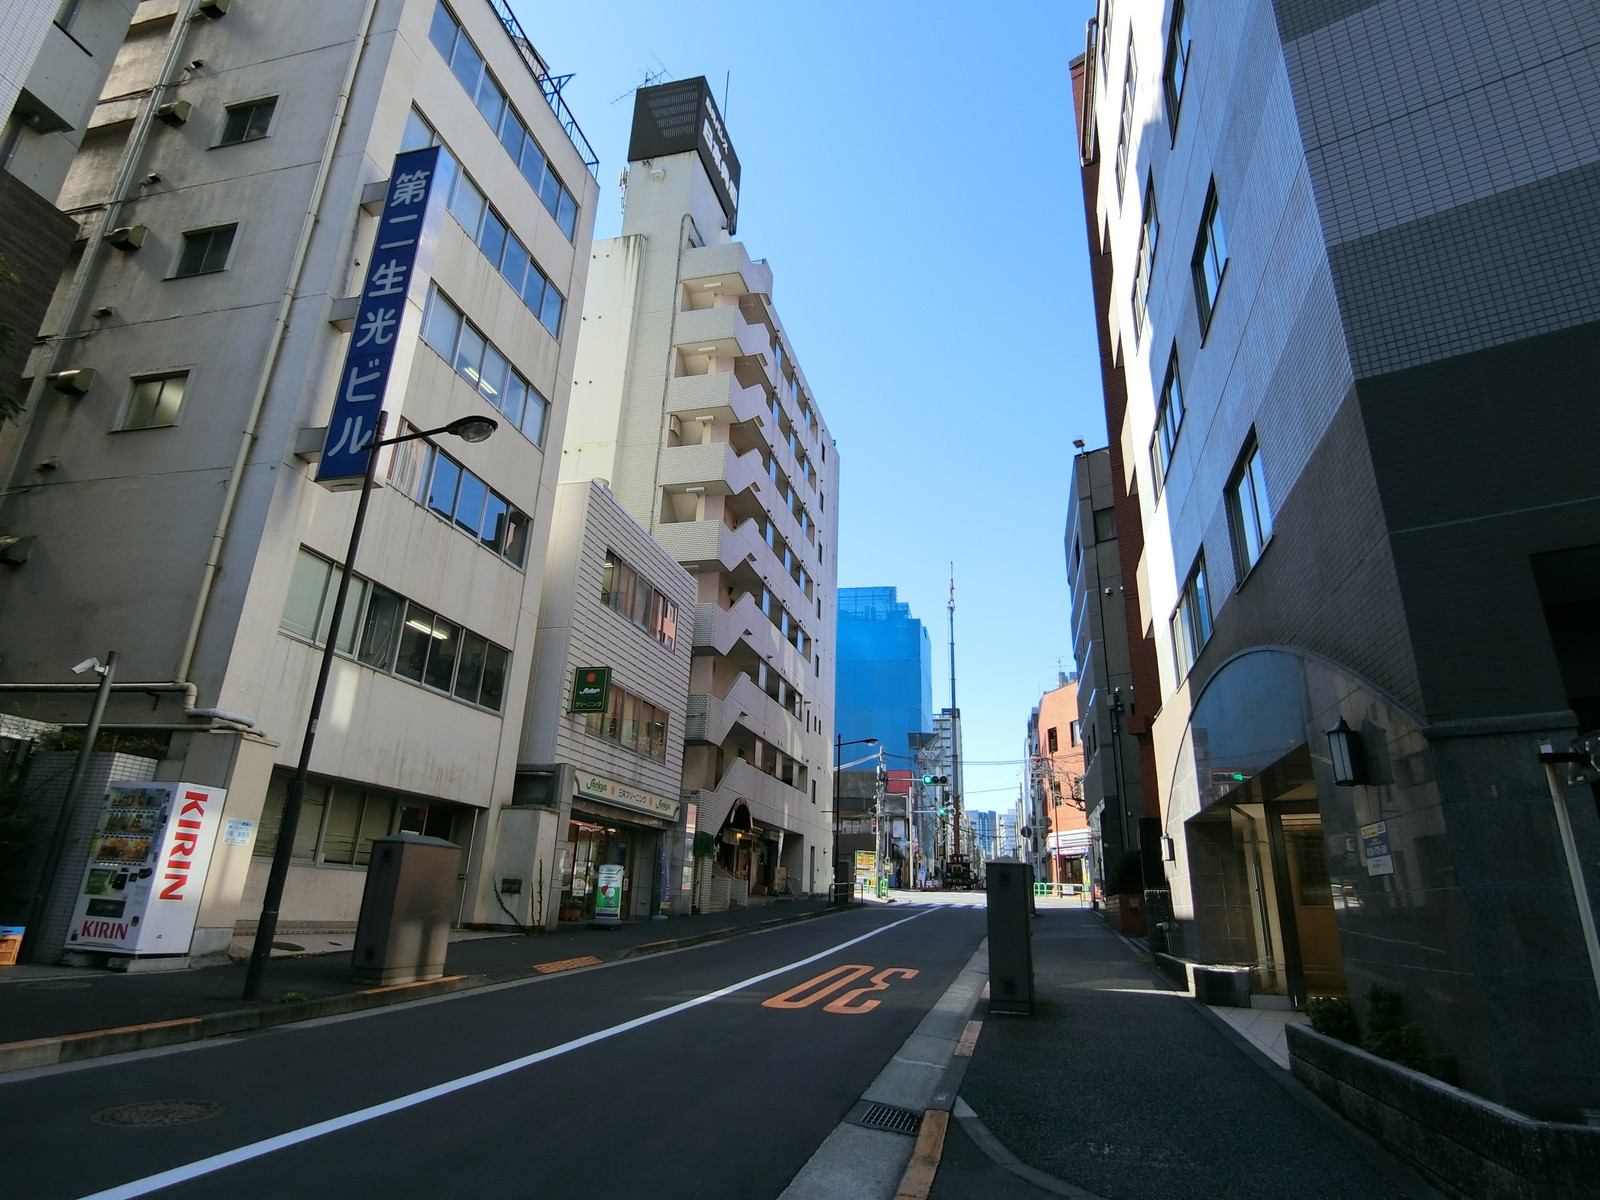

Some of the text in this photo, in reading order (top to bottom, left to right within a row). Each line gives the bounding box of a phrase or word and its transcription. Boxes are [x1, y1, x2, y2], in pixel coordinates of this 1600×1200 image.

[327, 169, 431, 457] 第二生光ビル
[586, 778, 608, 793] Sankyo
[158, 790, 209, 901] KIRIN
[81, 920, 129, 940] KIRIN
[761, 964, 920, 1014] 30
